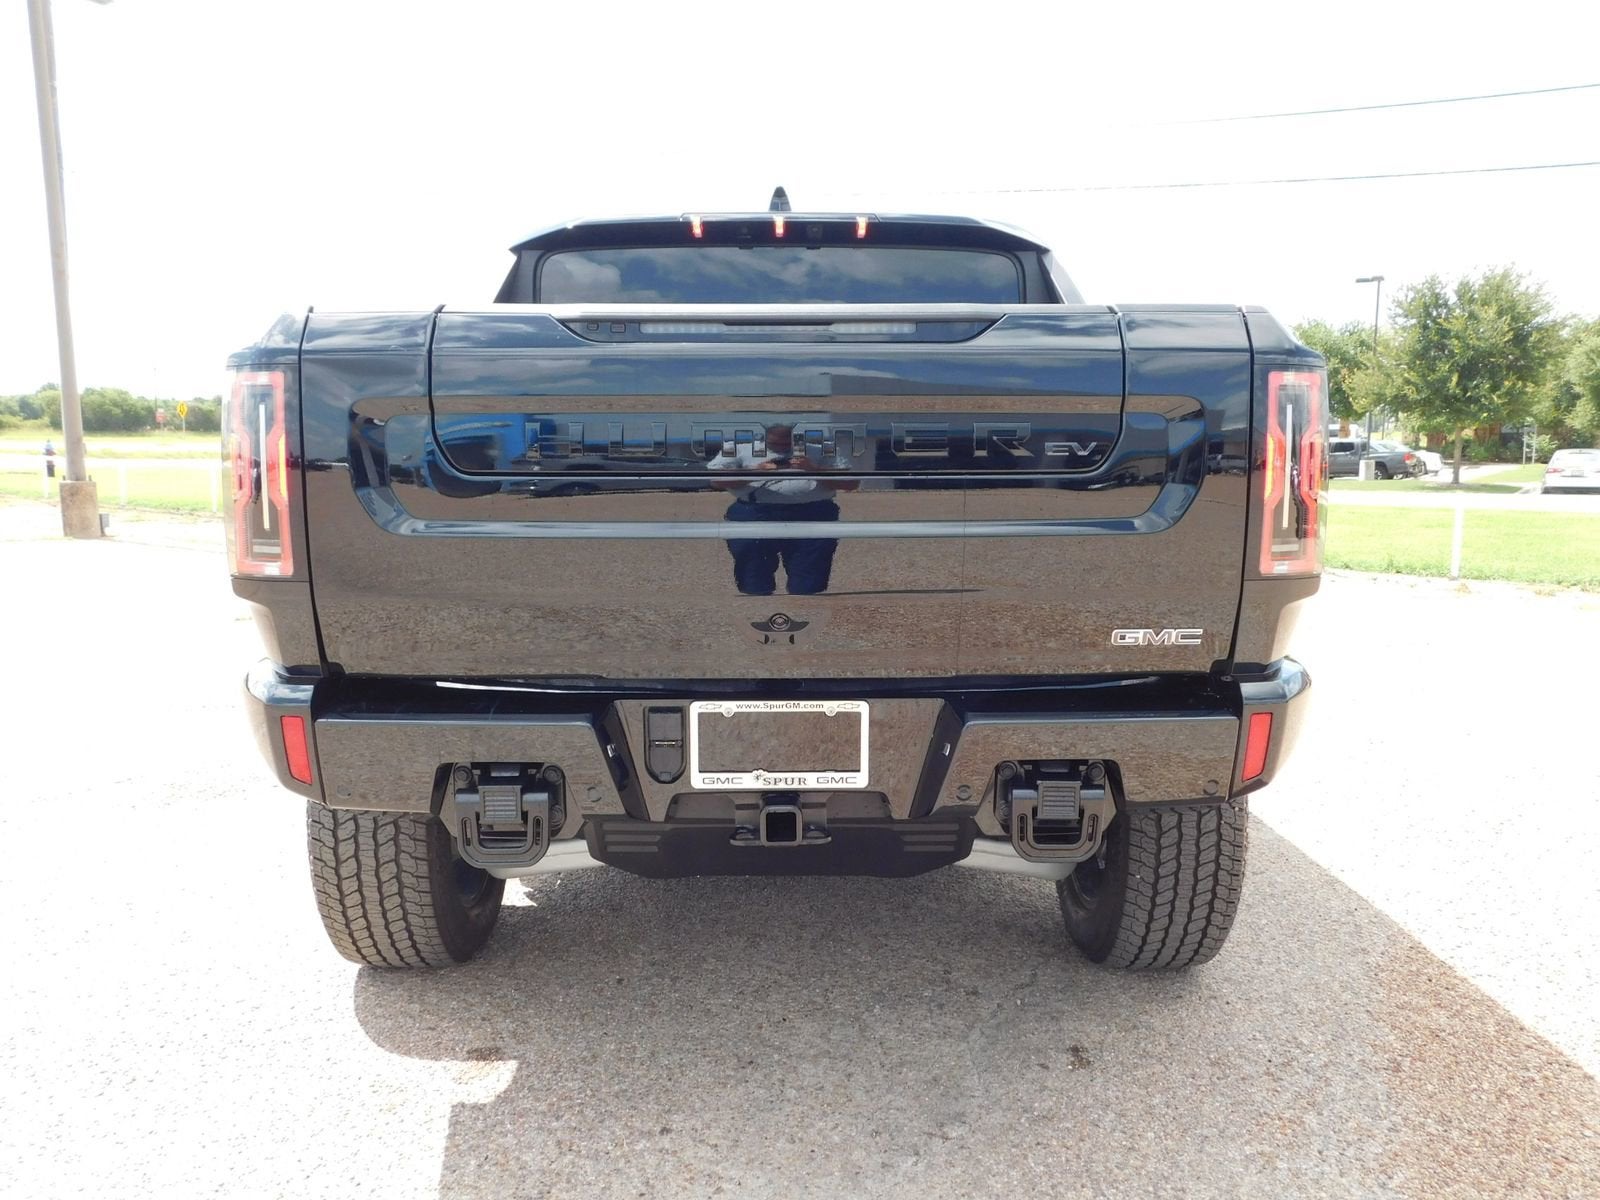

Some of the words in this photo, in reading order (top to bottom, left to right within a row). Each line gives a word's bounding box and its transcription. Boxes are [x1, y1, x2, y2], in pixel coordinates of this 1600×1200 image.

[525, 422, 1034, 460] HUMMER
[1044, 442, 1097, 456] EV
[1111, 629, 1203, 646] GMC
[735, 702, 824, 710] www.SpurGM.com
[702, 777, 744, 785] GMC
[762, 777, 808, 786] SPUR
[816, 776, 858, 785] GMC
